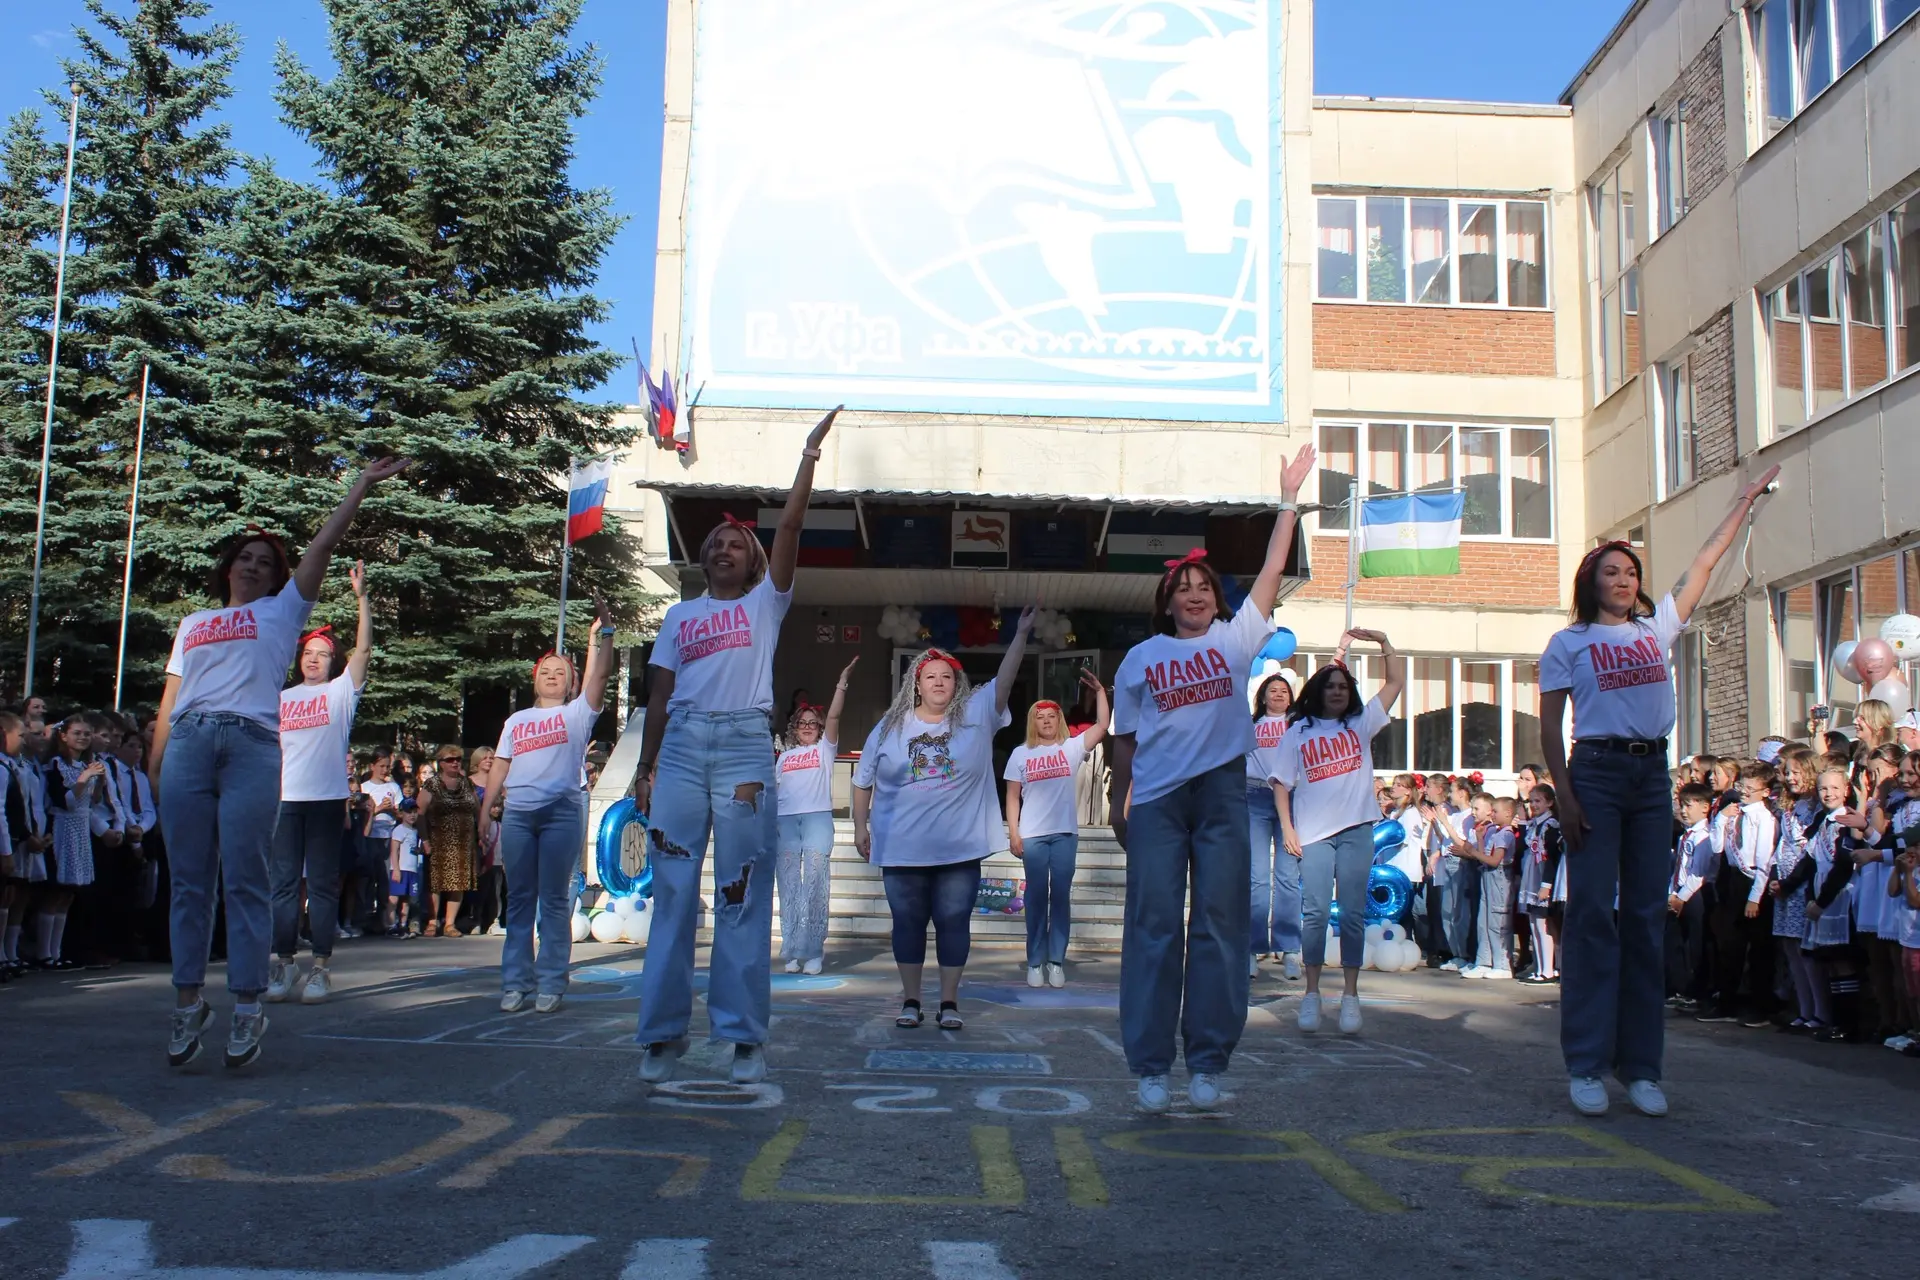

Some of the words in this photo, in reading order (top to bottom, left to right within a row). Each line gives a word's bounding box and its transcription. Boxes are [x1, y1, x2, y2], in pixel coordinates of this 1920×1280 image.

[790, 301, 901, 373] Уфа
[184, 625, 258, 652] ЫПУСКНИЦЫ
[675, 604, 751, 648] МАМА
[1145, 648, 1231, 693] МАМА
[281, 695, 328, 719] МАМА
[1153, 677, 1232, 713] ВЫПУСКНИКА
[280, 714, 330, 732] ЫПУСКНИКА
[512, 713, 566, 744] МАМА
[1256, 721, 1289, 738] МАМ
[1026, 750, 1069, 772] МАМА
[1301, 730, 1362, 768] МАМА
